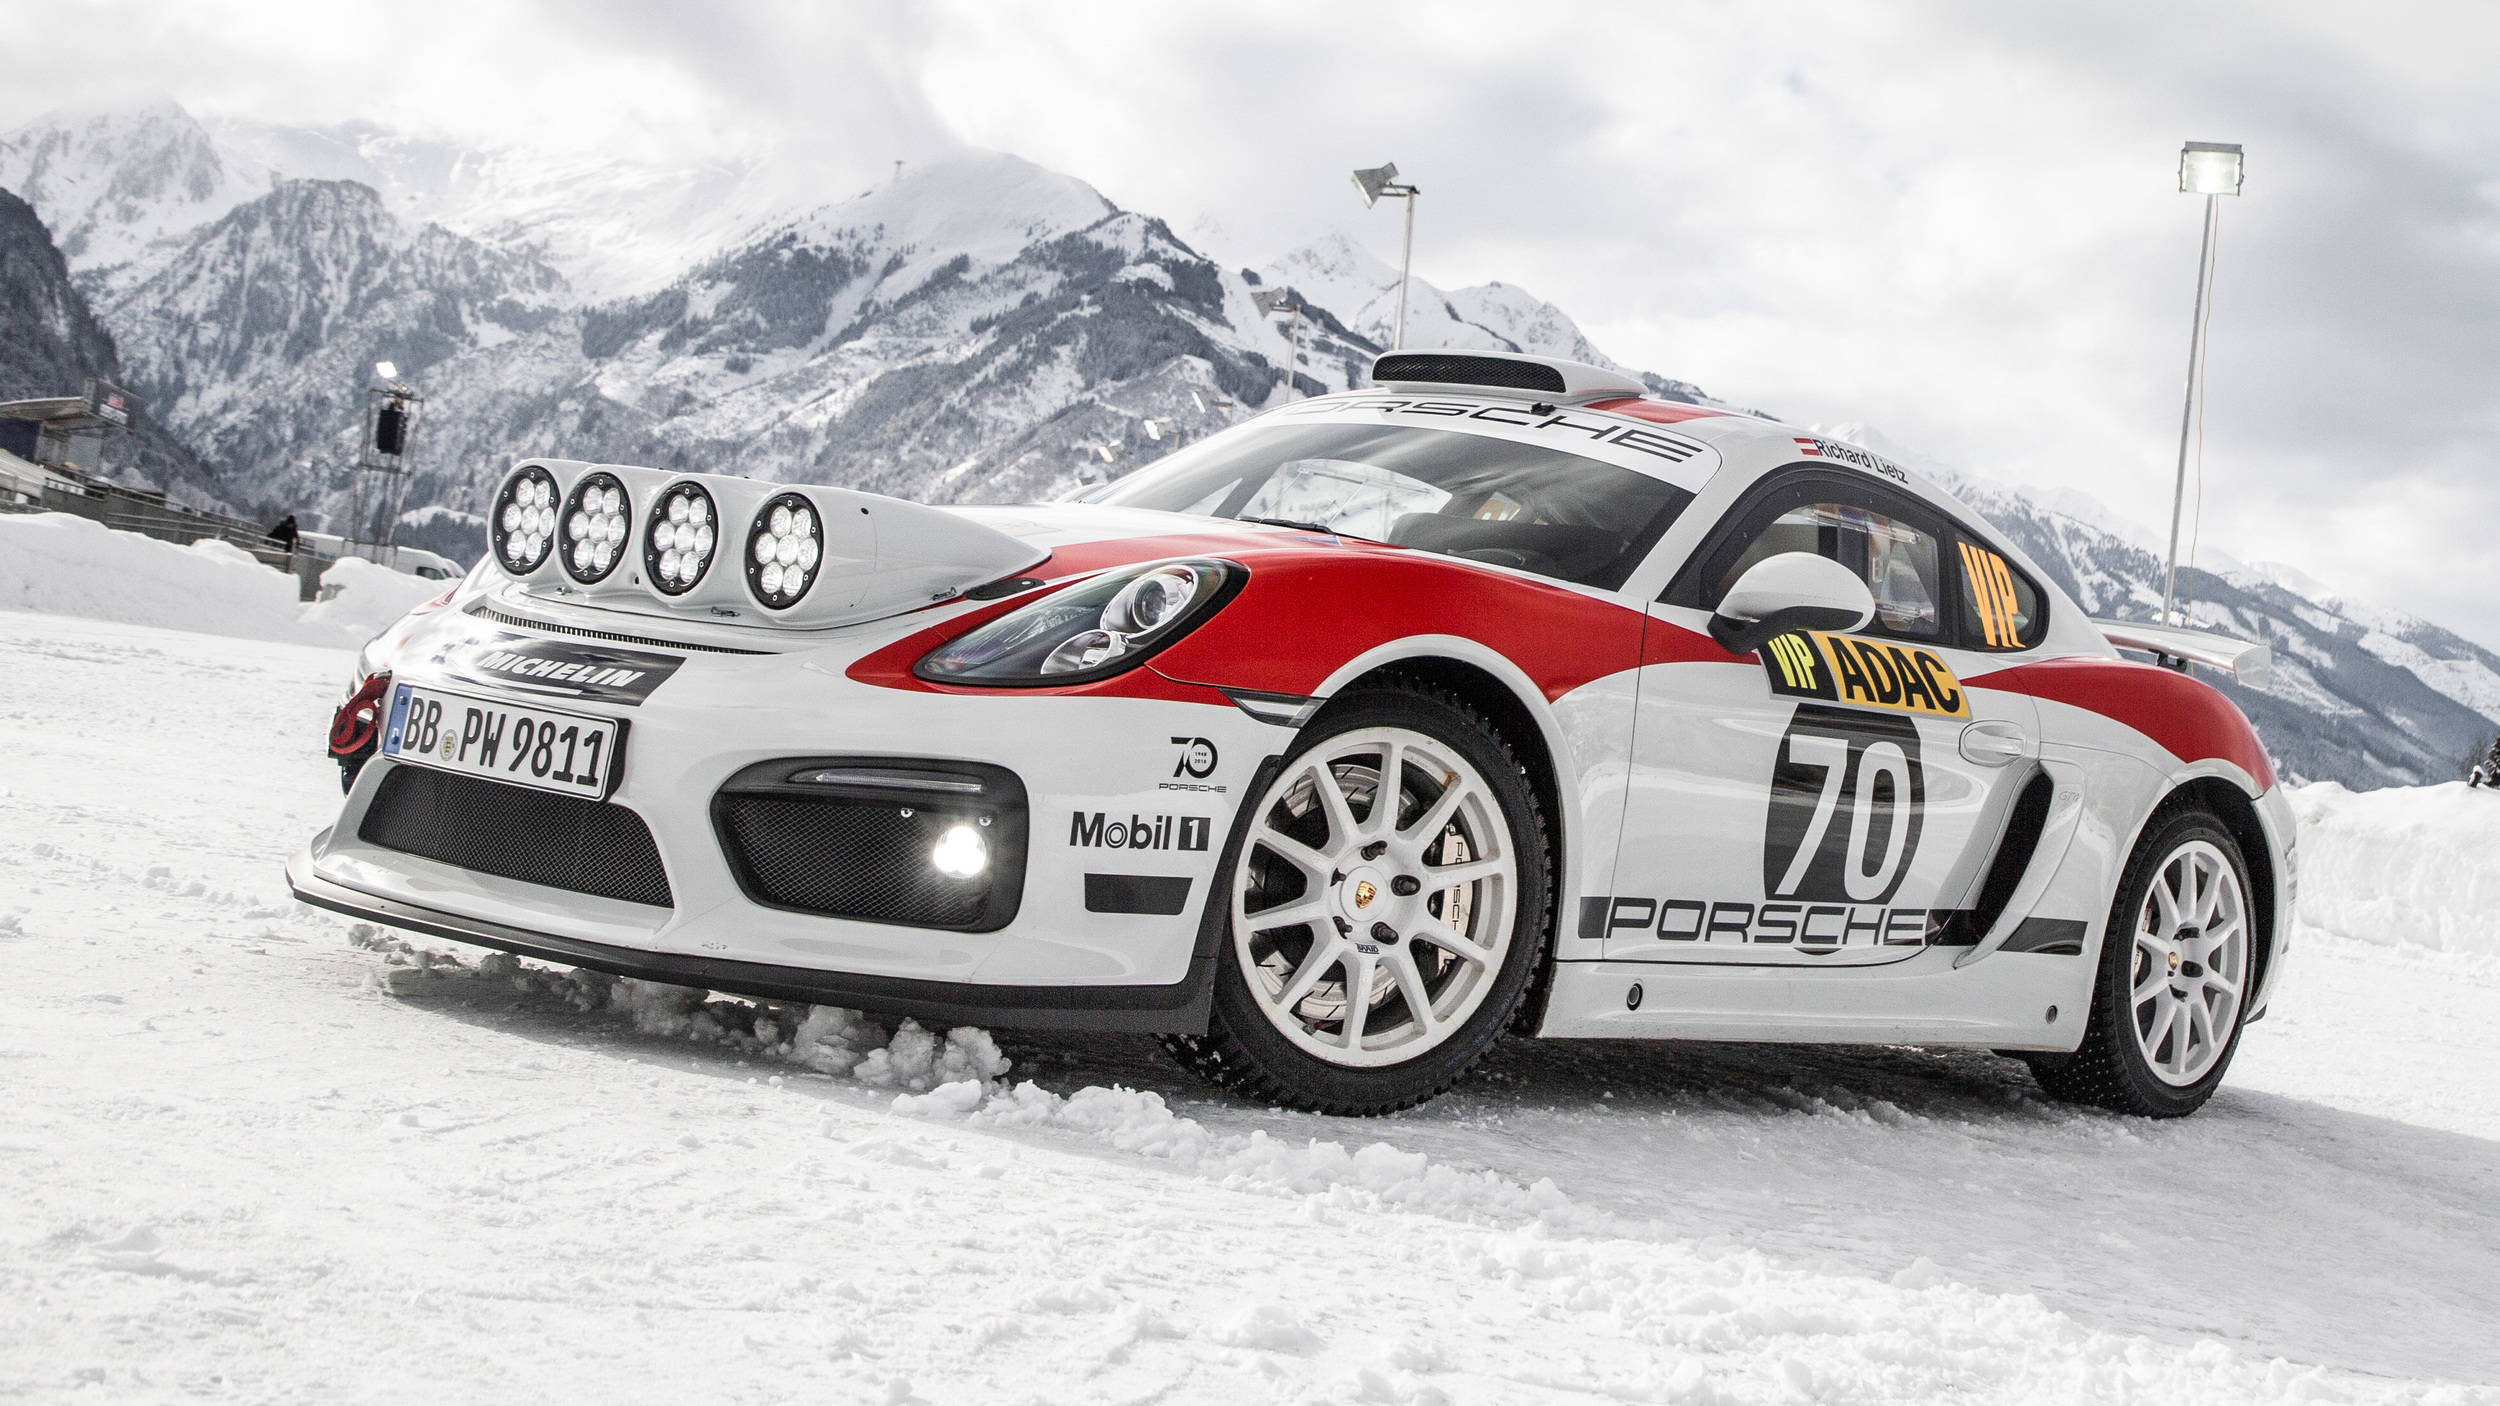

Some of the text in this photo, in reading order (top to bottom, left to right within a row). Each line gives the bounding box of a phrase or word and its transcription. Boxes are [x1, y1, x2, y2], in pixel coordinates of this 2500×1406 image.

[1812, 439, 1909, 484] Richard Lietz
[1958, 541, 2026, 648] VIP
[478, 651, 646, 687] MICHELIN
[1768, 633, 1960, 713] VIP ADAC
[403, 697, 604, 787] BB PW 9811
[1171, 736, 1218, 779] 70
[1158, 783, 1227, 793] PORSCHE
[1069, 811, 1173, 850] Mobil
[1774, 734, 1911, 900] 70
[1605, 896, 1927, 946] PORSCHE
